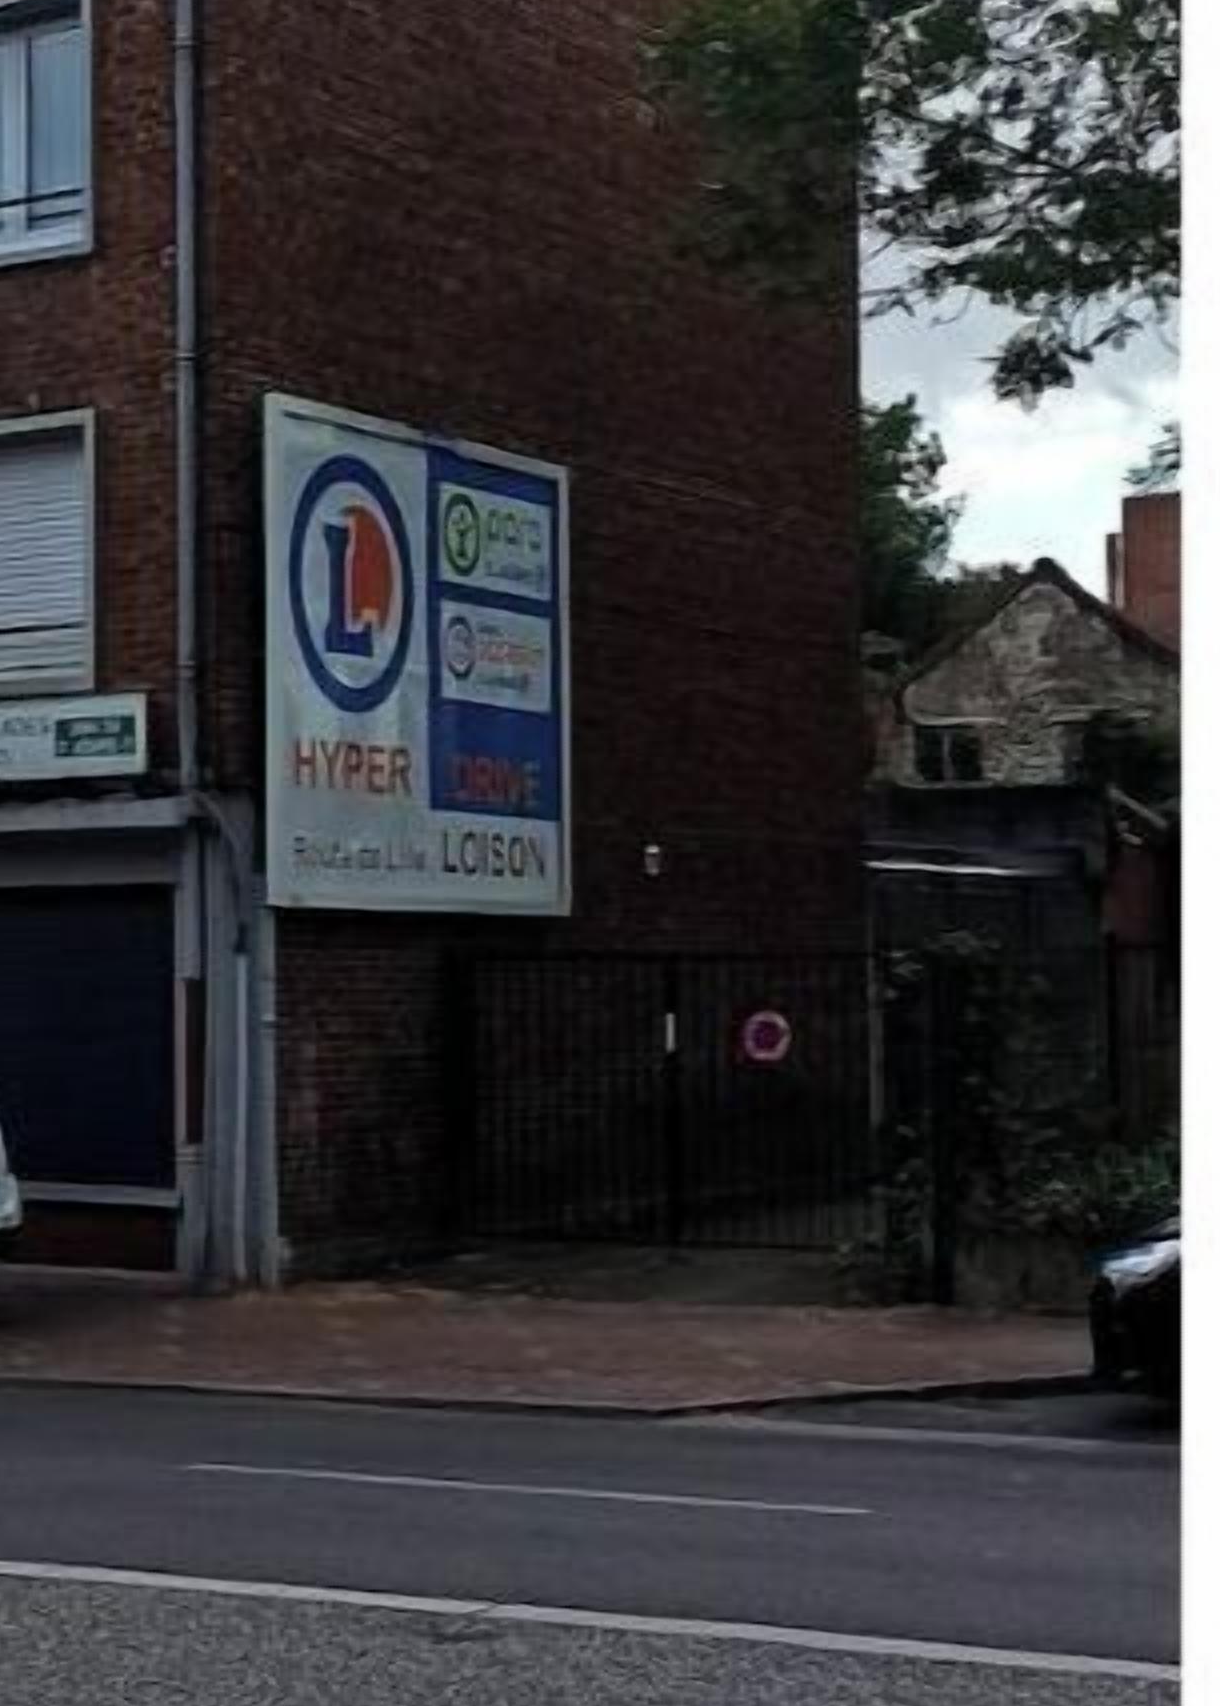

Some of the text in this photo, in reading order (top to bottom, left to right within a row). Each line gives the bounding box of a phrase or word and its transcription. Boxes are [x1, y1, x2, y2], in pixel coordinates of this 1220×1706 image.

[294, 736, 413, 797] HYPER
[444, 756, 542, 809] DRIVE
[441, 830, 546, 878] LOISON
